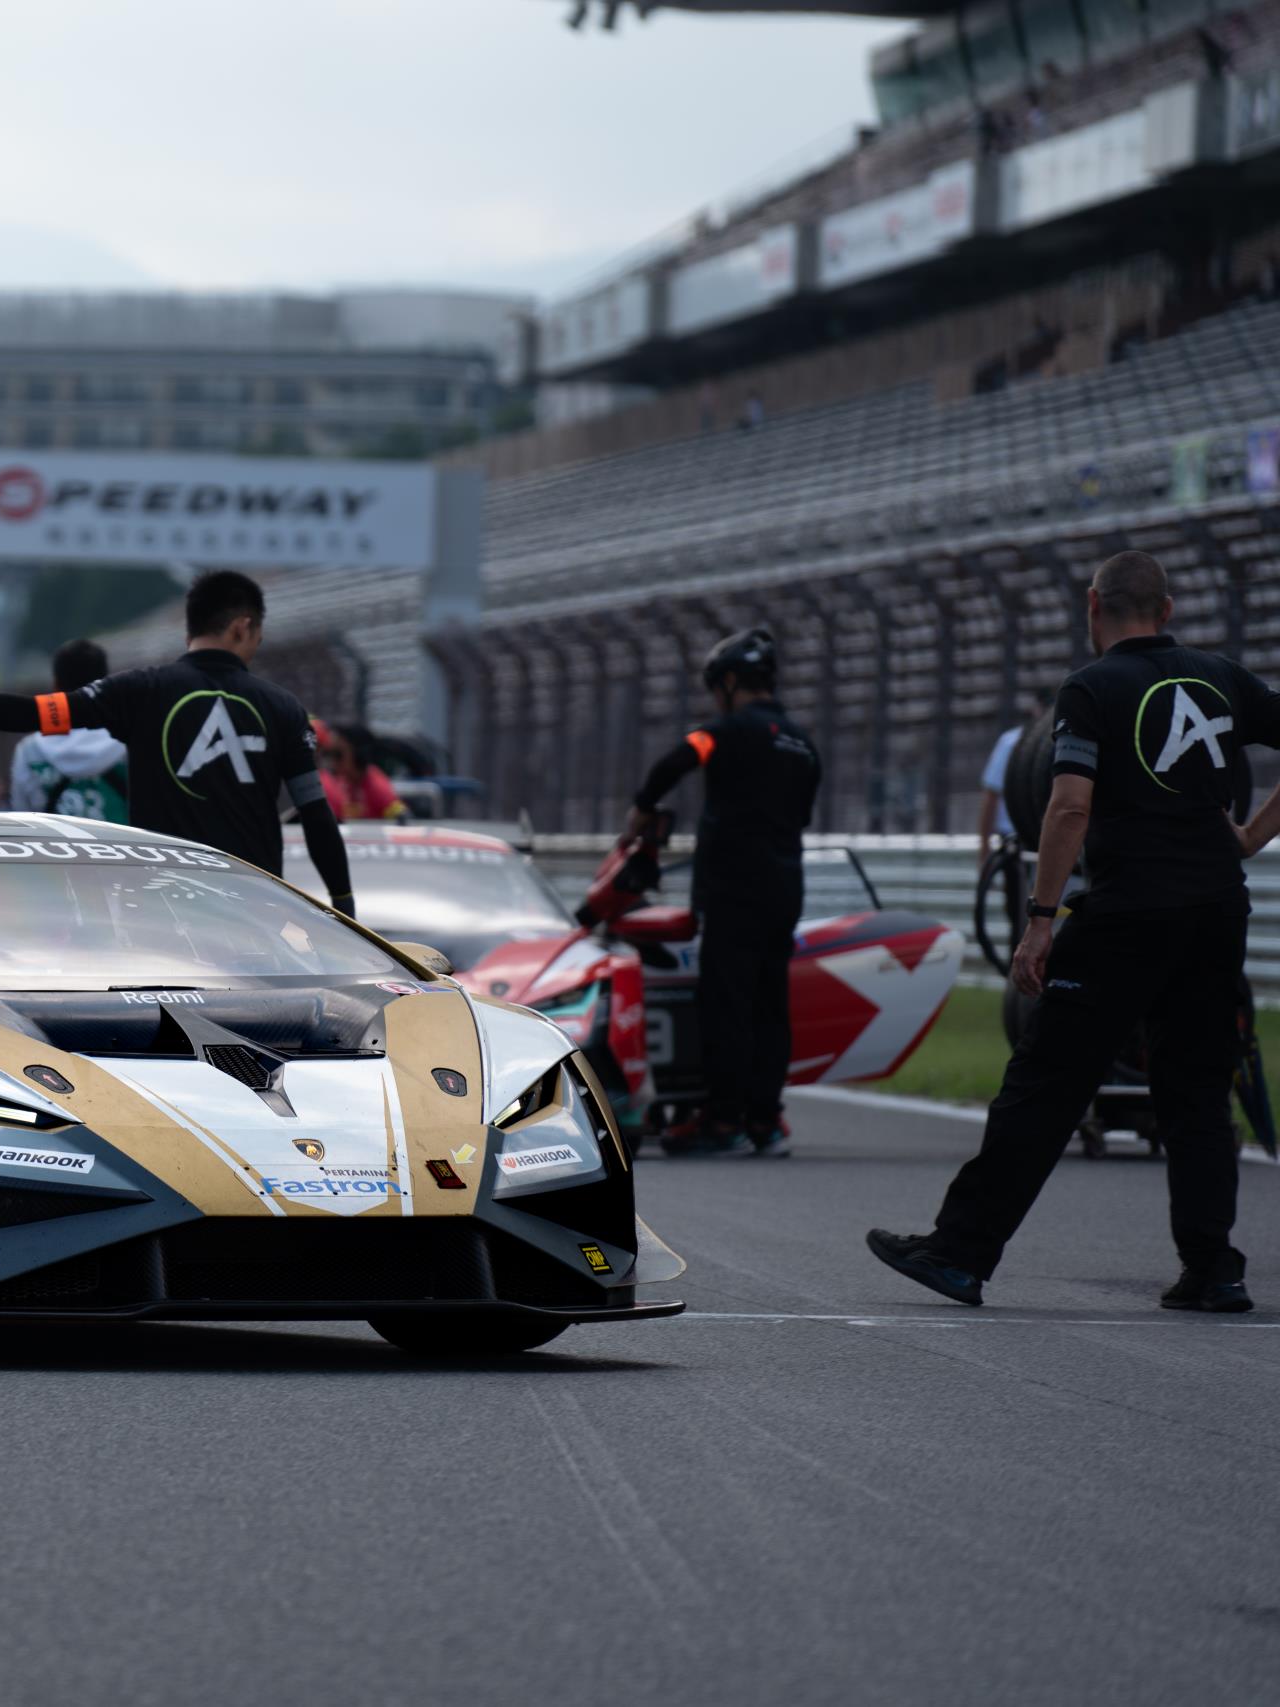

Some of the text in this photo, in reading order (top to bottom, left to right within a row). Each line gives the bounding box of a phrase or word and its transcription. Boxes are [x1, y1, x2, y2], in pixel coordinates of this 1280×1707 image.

[120, 991, 205, 1005] Redmi
[323, 1169, 392, 1178] PERTAMINA
[260, 1177, 402, 1194] Fastron
[585, 1251, 606, 1266] OMP
